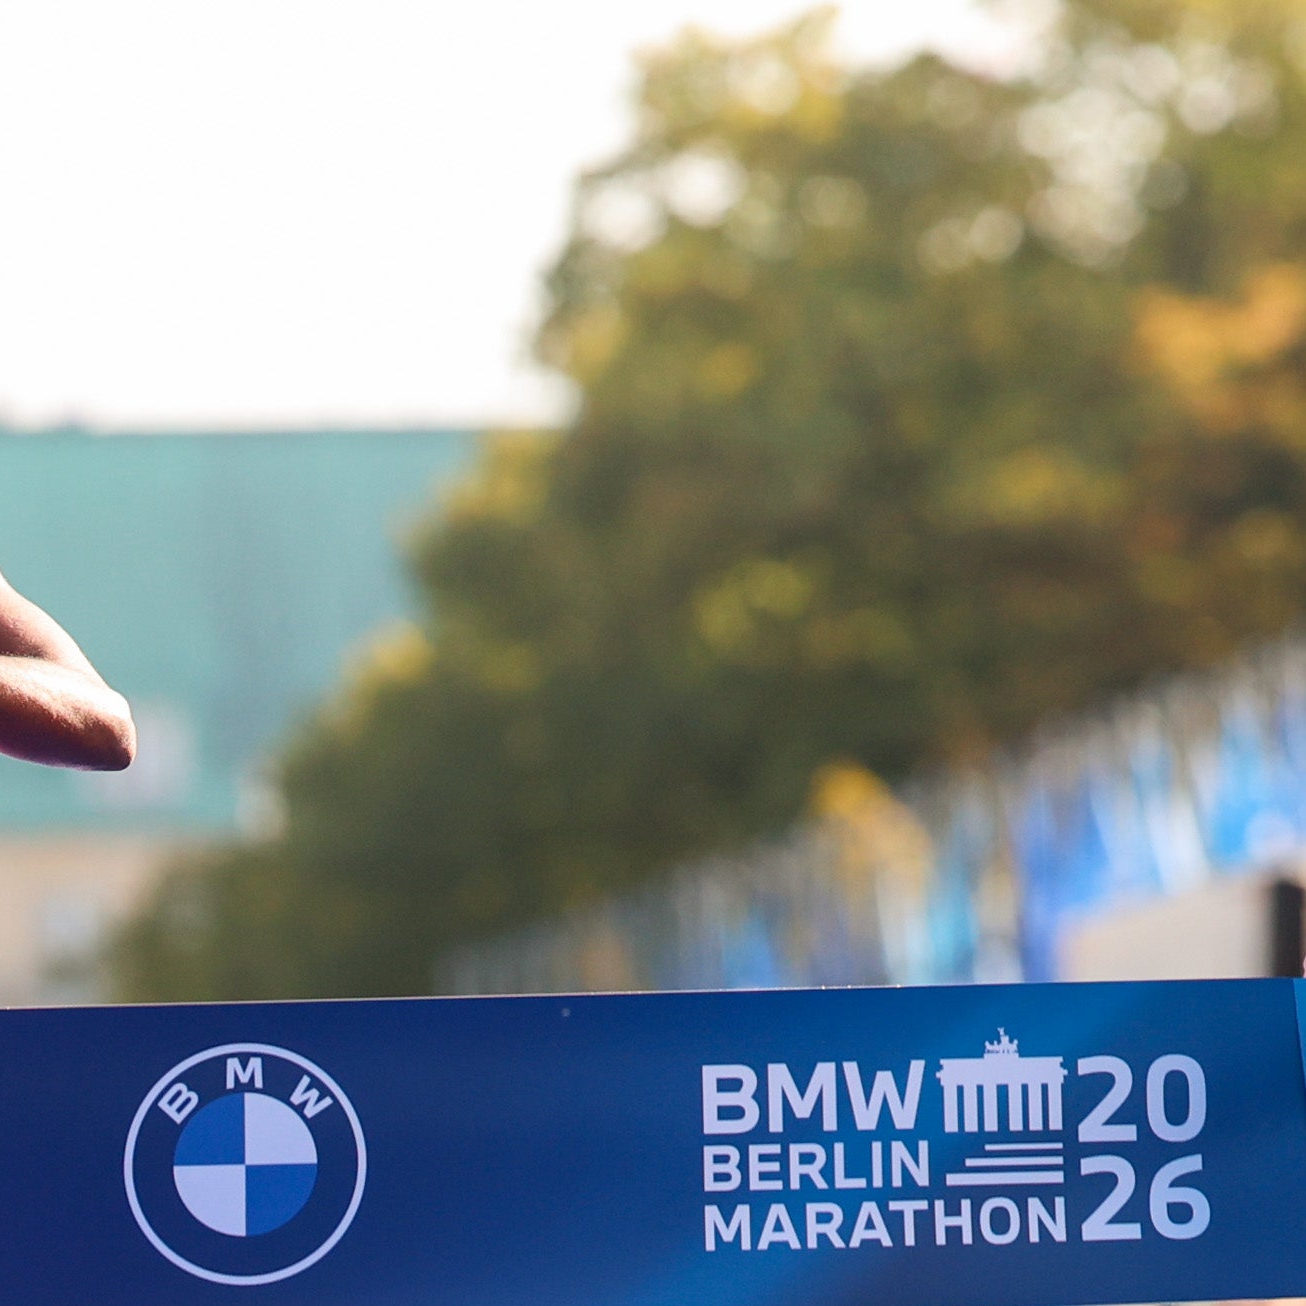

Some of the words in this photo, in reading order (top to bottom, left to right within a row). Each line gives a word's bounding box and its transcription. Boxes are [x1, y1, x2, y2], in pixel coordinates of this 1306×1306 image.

[157, 1056, 334, 1125] BMW
[702, 1059, 926, 1135] BMW
[1077, 1054, 1207, 1143] 20
[703, 1140, 930, 1192] BERLIN
[1081, 1154, 1211, 1242] 26
[705, 1196, 1067, 1252] MARATHON
